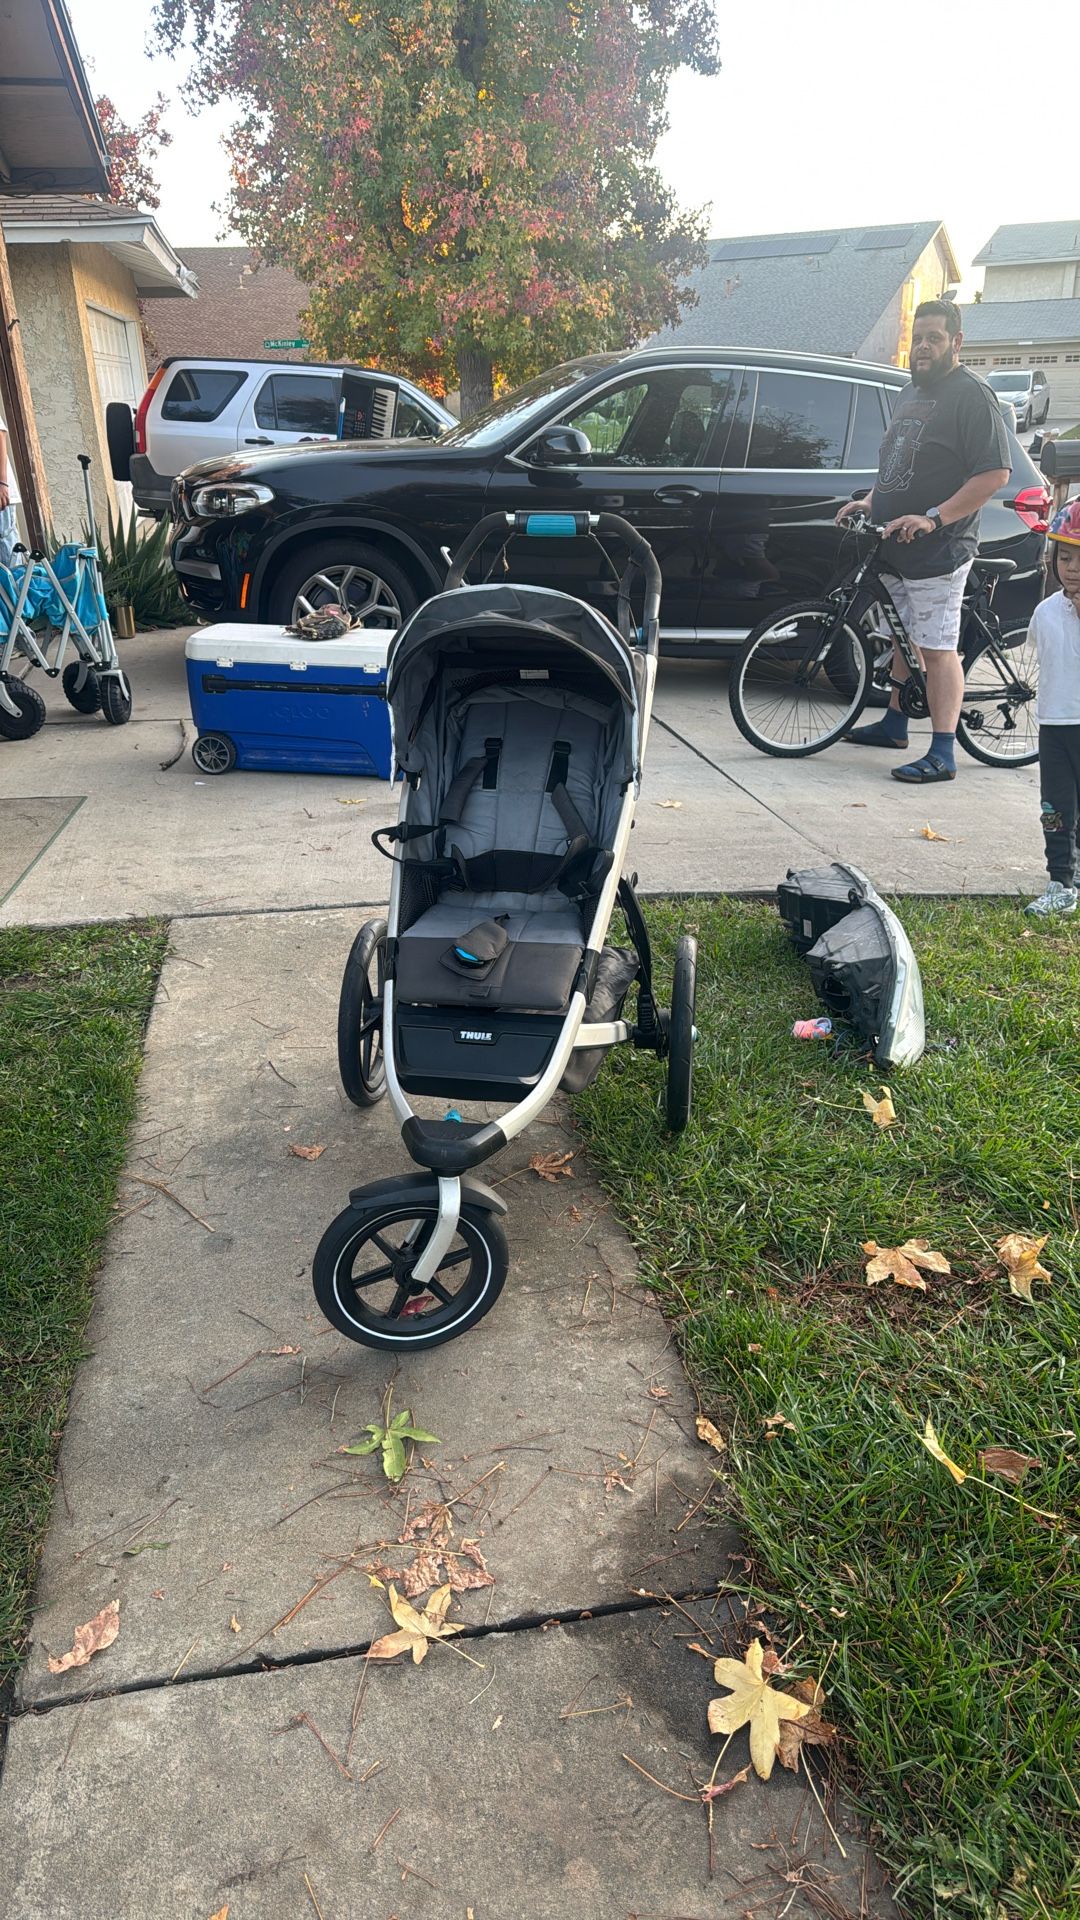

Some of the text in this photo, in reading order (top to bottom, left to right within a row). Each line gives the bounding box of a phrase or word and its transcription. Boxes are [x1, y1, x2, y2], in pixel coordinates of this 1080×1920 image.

[270, 340, 295, 348] McKinley
[883, 604, 920, 669] HUFFY
[460, 1031, 492, 1041] THULE
